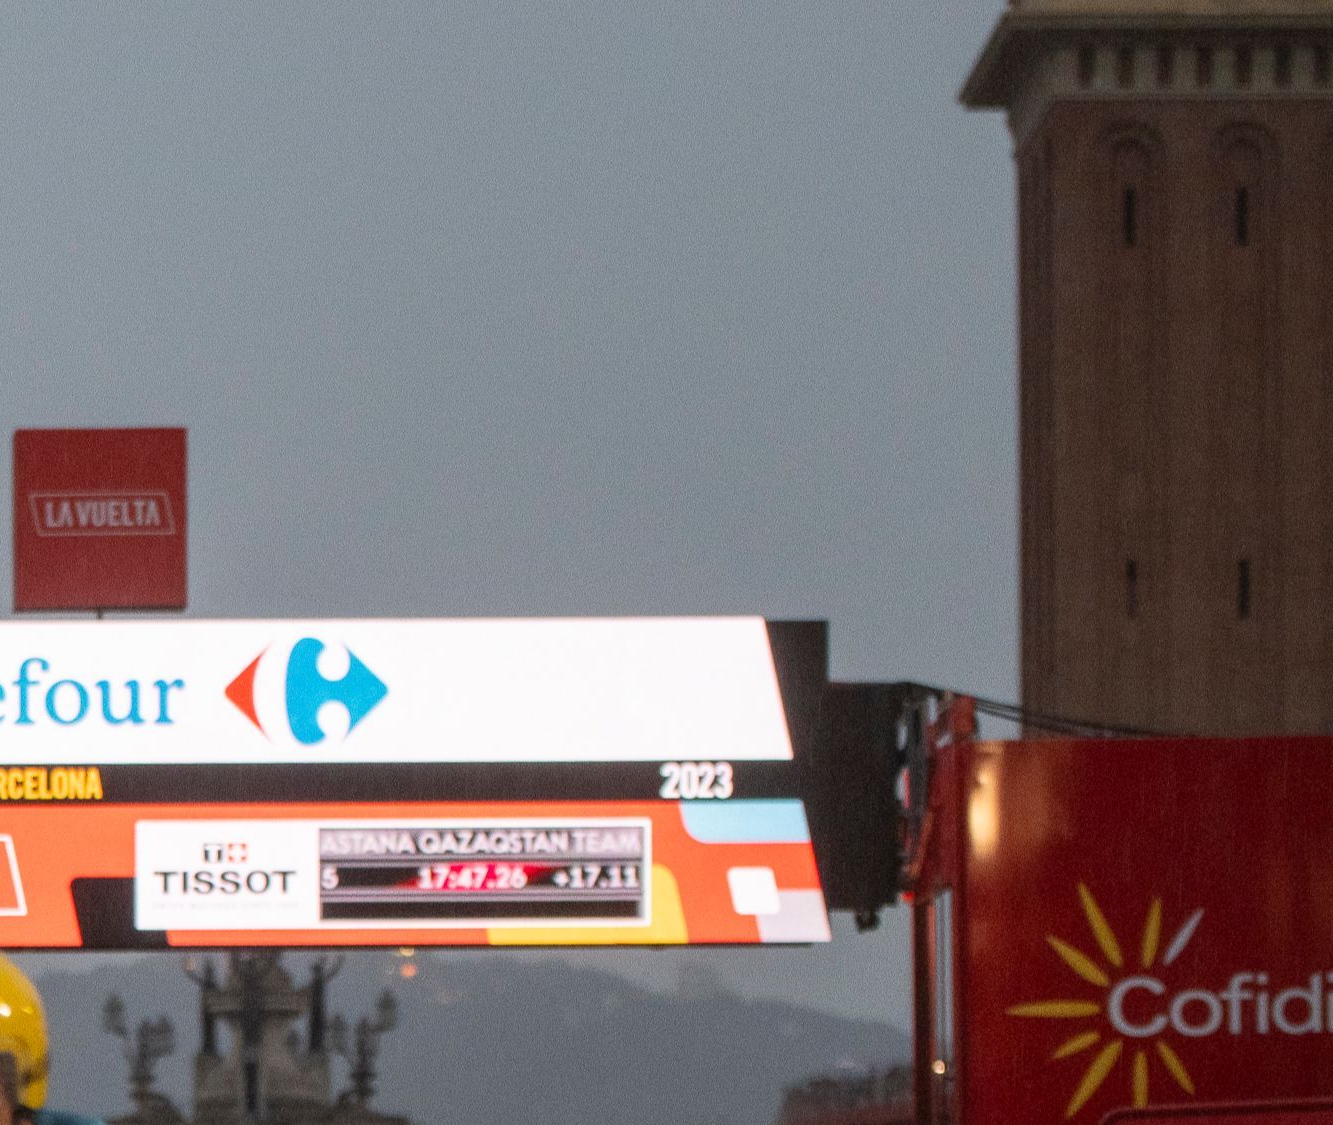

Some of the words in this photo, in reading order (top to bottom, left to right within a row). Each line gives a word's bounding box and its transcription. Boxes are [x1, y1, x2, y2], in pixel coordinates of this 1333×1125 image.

[45, 501, 74, 529] LA
[76, 499, 161, 528] VUELTA
[659, 761, 734, 799] 2023
[321, 833, 416, 854] ASTANA
[417, 832, 569, 855] QAZAQSTAN
[570, 831, 642, 851] TEAM
[153, 870, 297, 895] TISSOT
[417, 867, 528, 890] 17:47.26
[551, 867, 640, 890] +17.11
